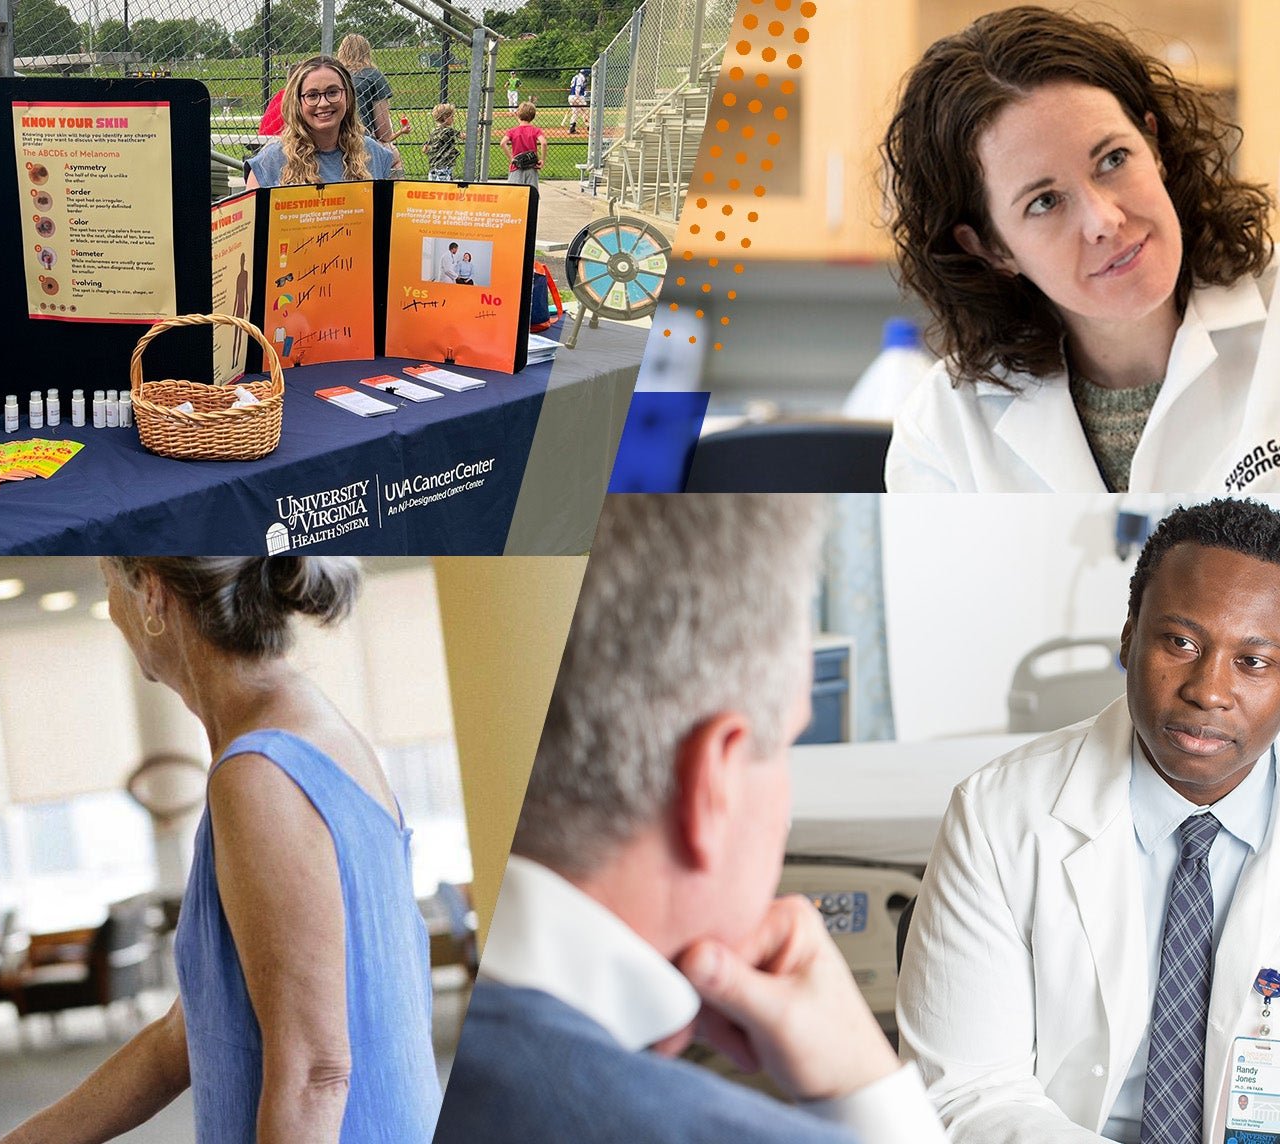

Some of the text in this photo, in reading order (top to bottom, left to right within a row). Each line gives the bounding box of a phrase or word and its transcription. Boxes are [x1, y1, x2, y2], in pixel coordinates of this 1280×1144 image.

[22, 117, 128, 128] KNOW YOUR SKIN
[64, 163, 106, 172] Asymmetry
[407, 190, 463, 201] QUESTION
[275, 199, 319, 210] QUESTION
[300, 211, 320, 219] practice
[72, 279, 102, 288] Evolving
[403, 286, 428, 298] Yes
[481, 294, 502, 306] No
[1224, 445, 1265, 492] susan
[384, 458, 495, 501] UVA Cancer Center
[277, 479, 369, 520] UNIVERSITY
[388, 506, 397, 515] An
[447, 485, 466, 497] Cancer
[466, 479, 484, 490] Center
[289, 498, 367, 533] of VIRGINIA
[292, 517, 369, 549] HEALTH SYSTEM
[1236, 1066, 1258, 1075] Randy
[1236, 1075, 1256, 1083] Jones
[1235, 1130, 1277, 1140] UNIVERSITY
